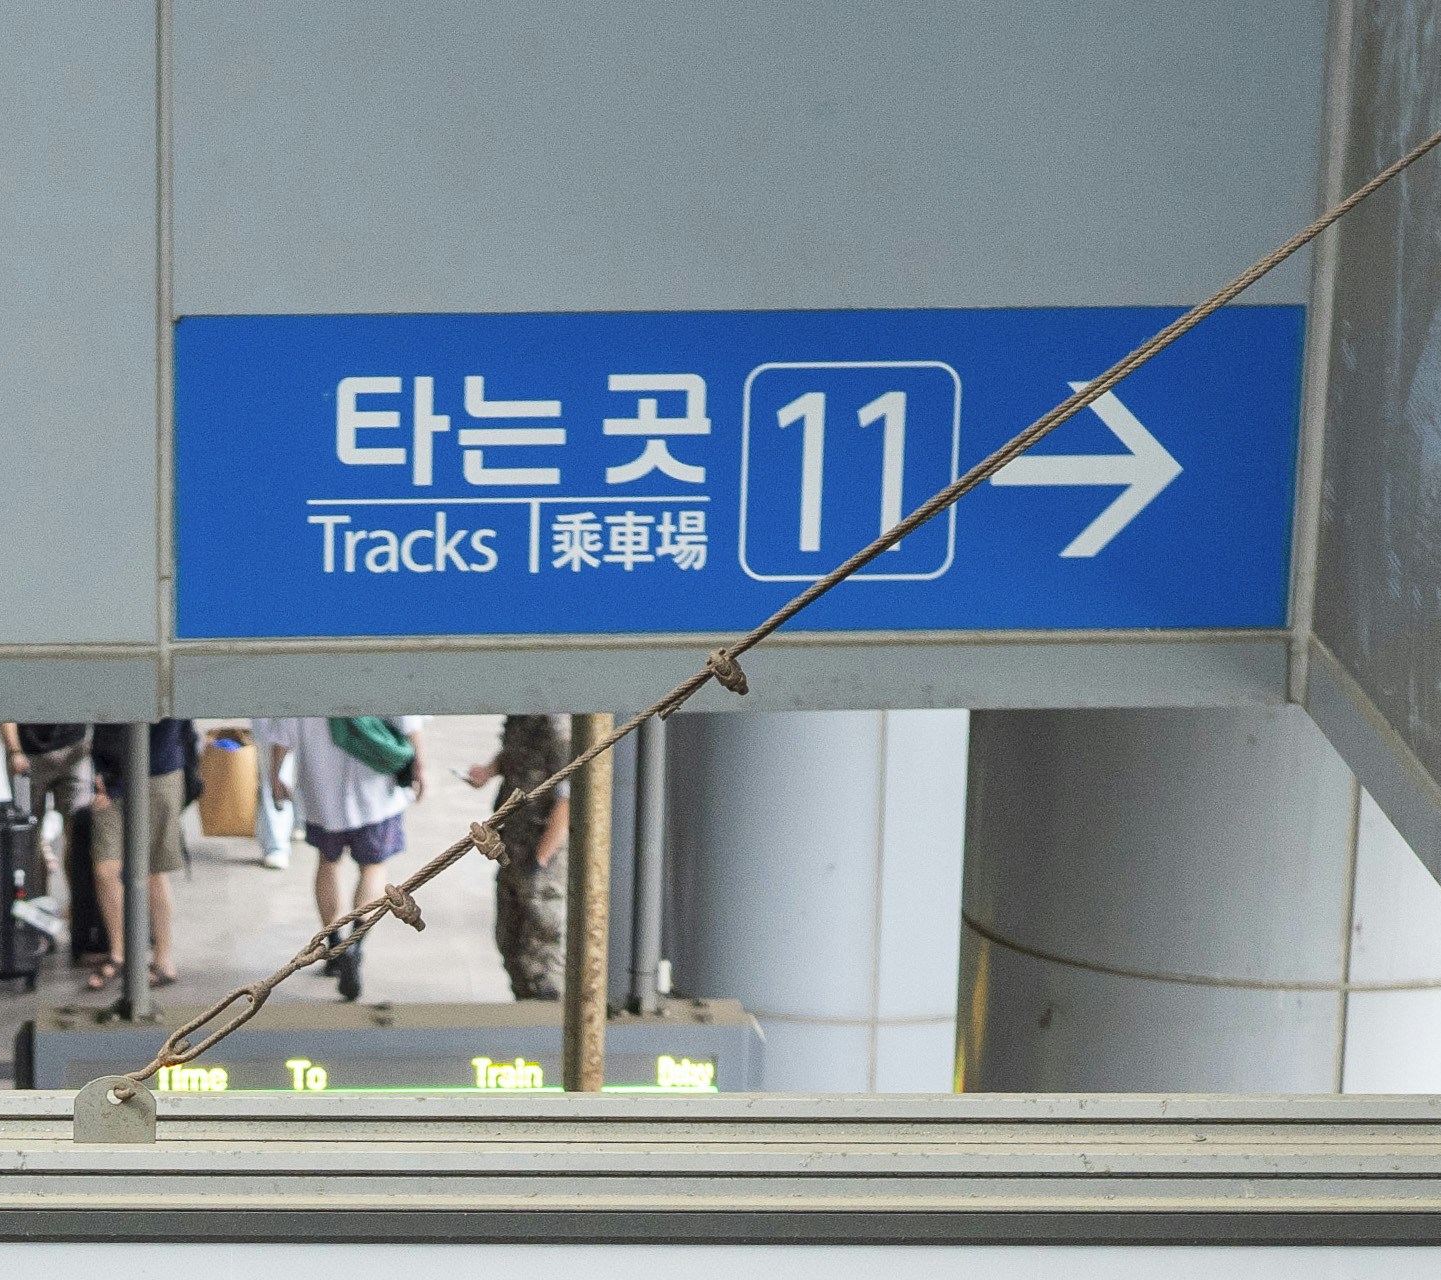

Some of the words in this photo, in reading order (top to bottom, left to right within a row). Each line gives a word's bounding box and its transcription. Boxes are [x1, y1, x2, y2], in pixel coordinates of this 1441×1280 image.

[335, 373, 567, 486] 타는
[602, 373, 712, 484] 곳
[776, 390, 907, 553] 11
[307, 510, 499, 575] Tracks
[285, 1058, 327, 1090] To
[471, 1056, 544, 1088] Train
